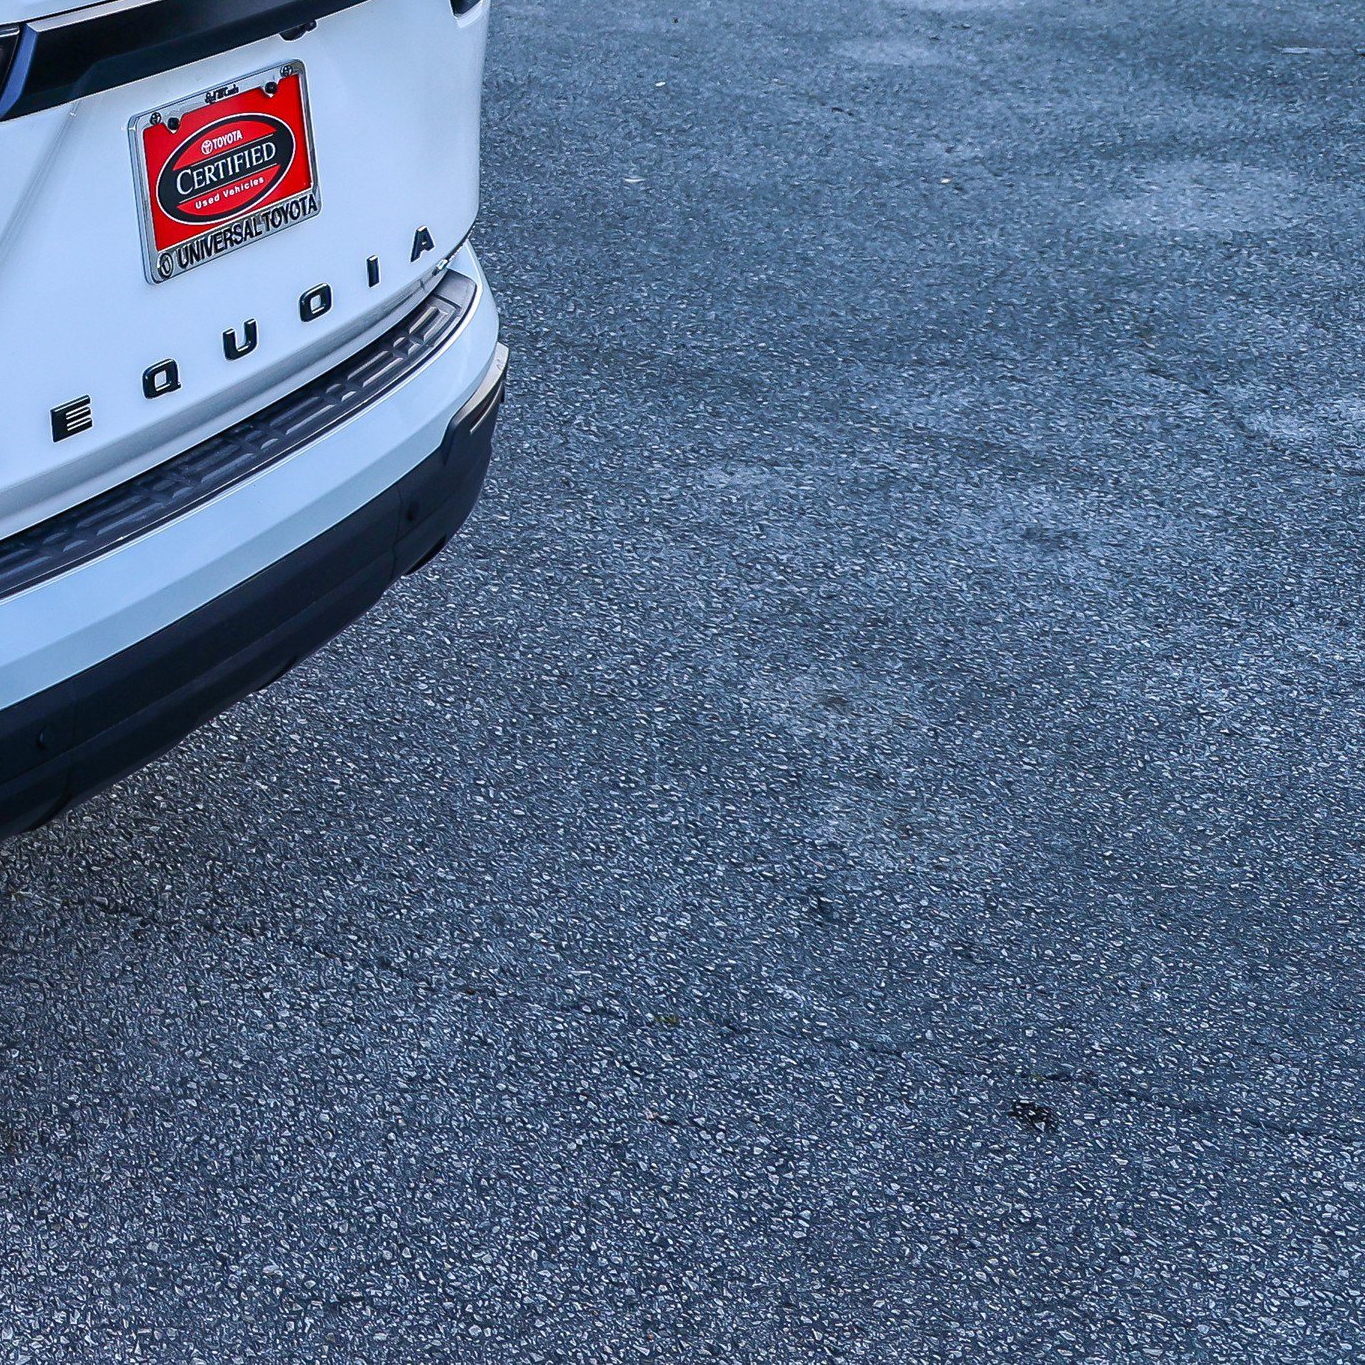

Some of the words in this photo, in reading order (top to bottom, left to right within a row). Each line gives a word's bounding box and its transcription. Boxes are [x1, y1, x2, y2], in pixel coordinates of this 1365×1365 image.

[213, 129, 243, 149] TOYOTA
[176, 141, 276, 195] CERTIFIED
[195, 193, 220, 210] Used
[223, 176, 265, 198] Vehicles
[177, 217, 263, 269] UNIVERSAL
[261, 193, 318, 232] TOYOTA
